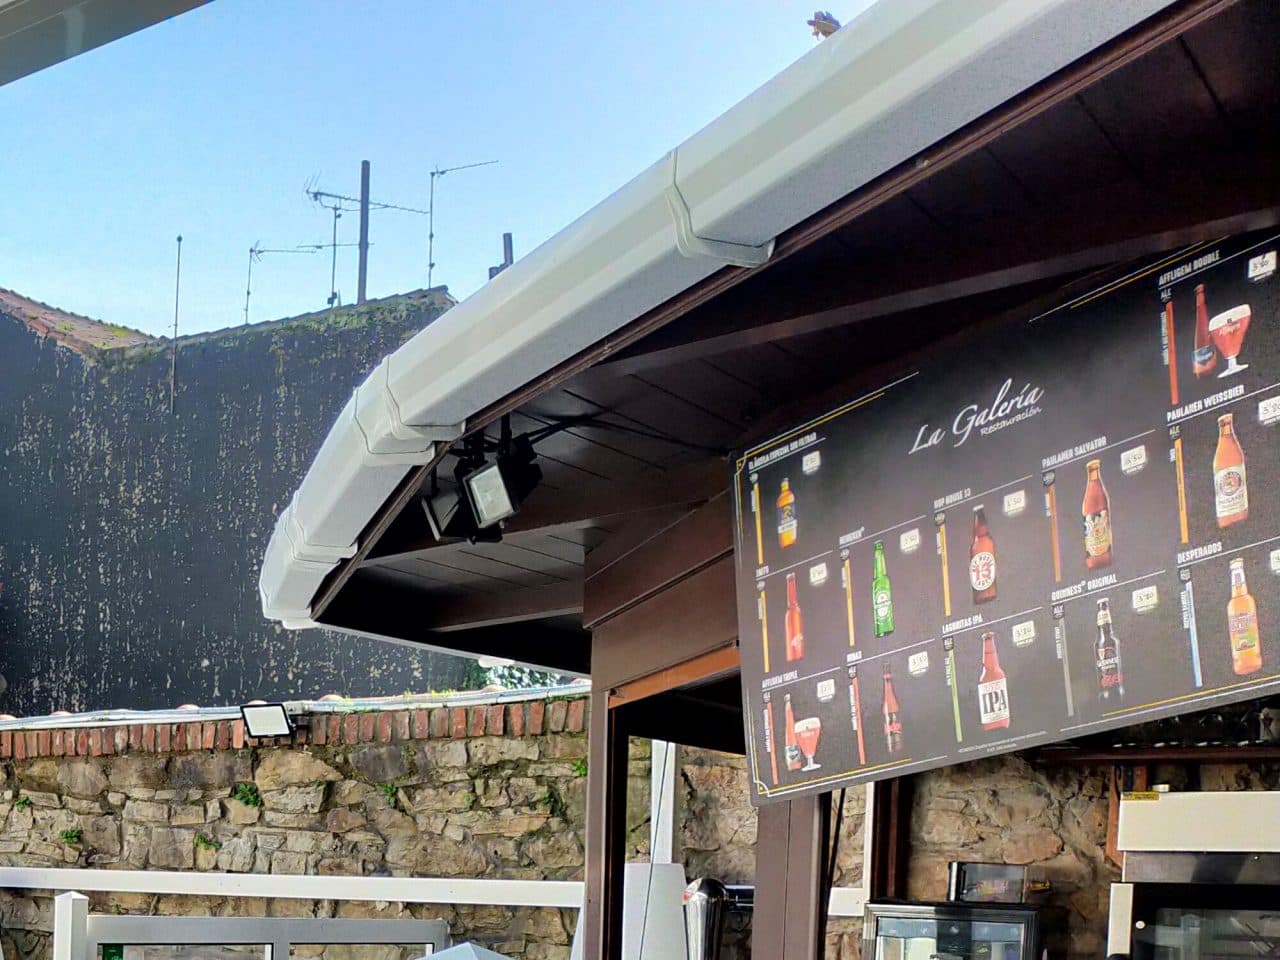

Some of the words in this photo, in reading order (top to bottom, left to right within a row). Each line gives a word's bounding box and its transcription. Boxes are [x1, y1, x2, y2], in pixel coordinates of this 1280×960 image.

[1158, 262, 1192, 285] AFFLIGEM
[1193, 250, 1220, 269] DOUBLE
[908, 424, 946, 455] La
[952, 377, 1044, 448] Galería
[1166, 401, 1203, 422] PAULANER
[1203, 384, 1245, 409] WEISSBIER
[980, 405, 1042, 436] Restauración
[1041, 449, 1074, 468] PAULANER
[1074, 436, 1107, 457] SALVATOR
[1177, 541, 1223, 564] DESPERADOS
[1087, 573, 1117, 590] ORIGINAL
[942, 617, 972, 634] LAGUNITAS
[972, 613, 984, 625] IPA
[982, 689, 1007, 715] IPA
